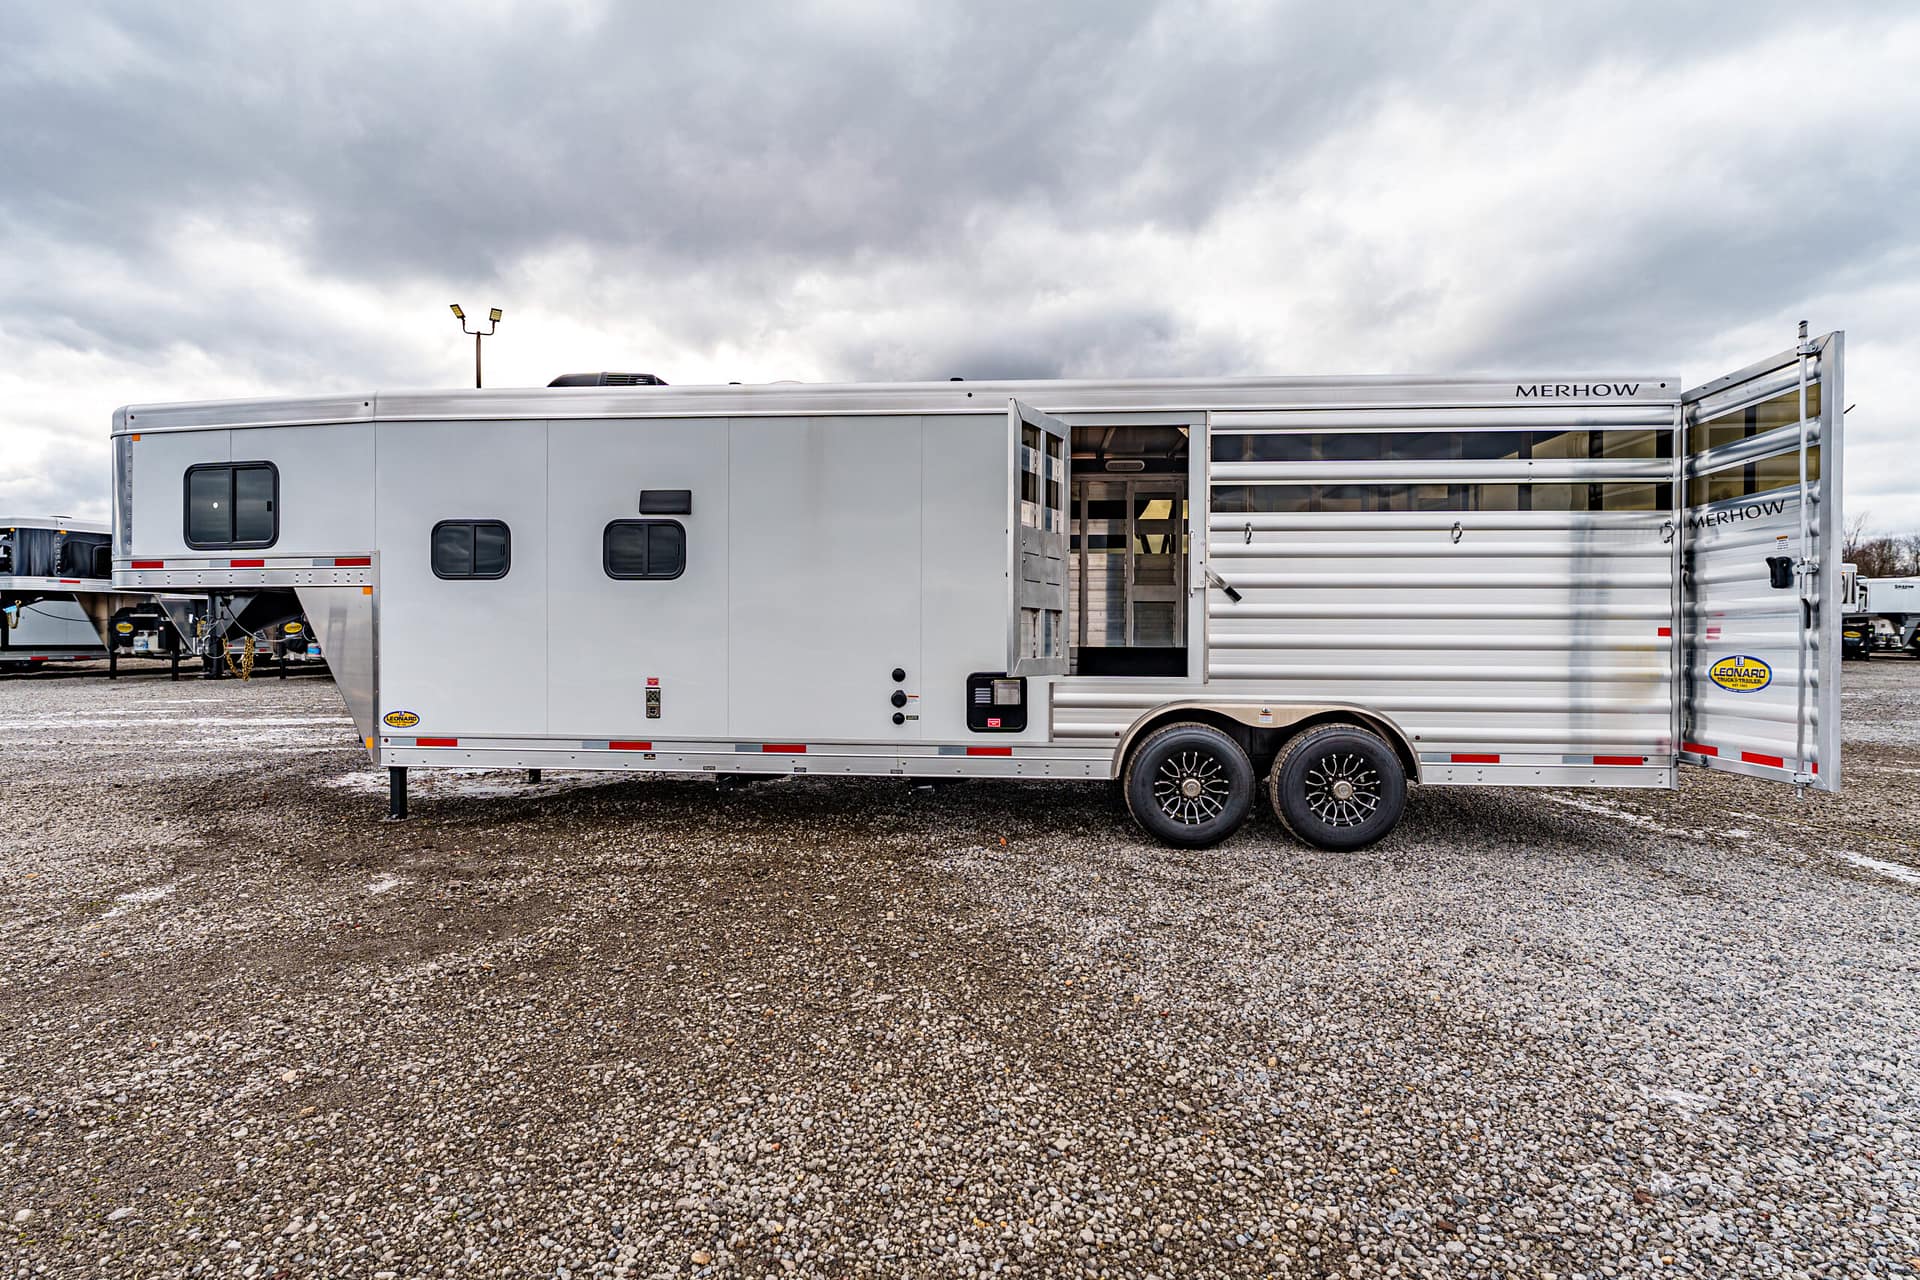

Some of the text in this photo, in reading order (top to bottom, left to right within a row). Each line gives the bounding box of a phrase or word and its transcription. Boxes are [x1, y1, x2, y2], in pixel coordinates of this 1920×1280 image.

[1516, 384, 1639, 397] MERHOW
[1689, 499, 1785, 530] MERHOW
[1714, 667, 1766, 678] LEONARD
